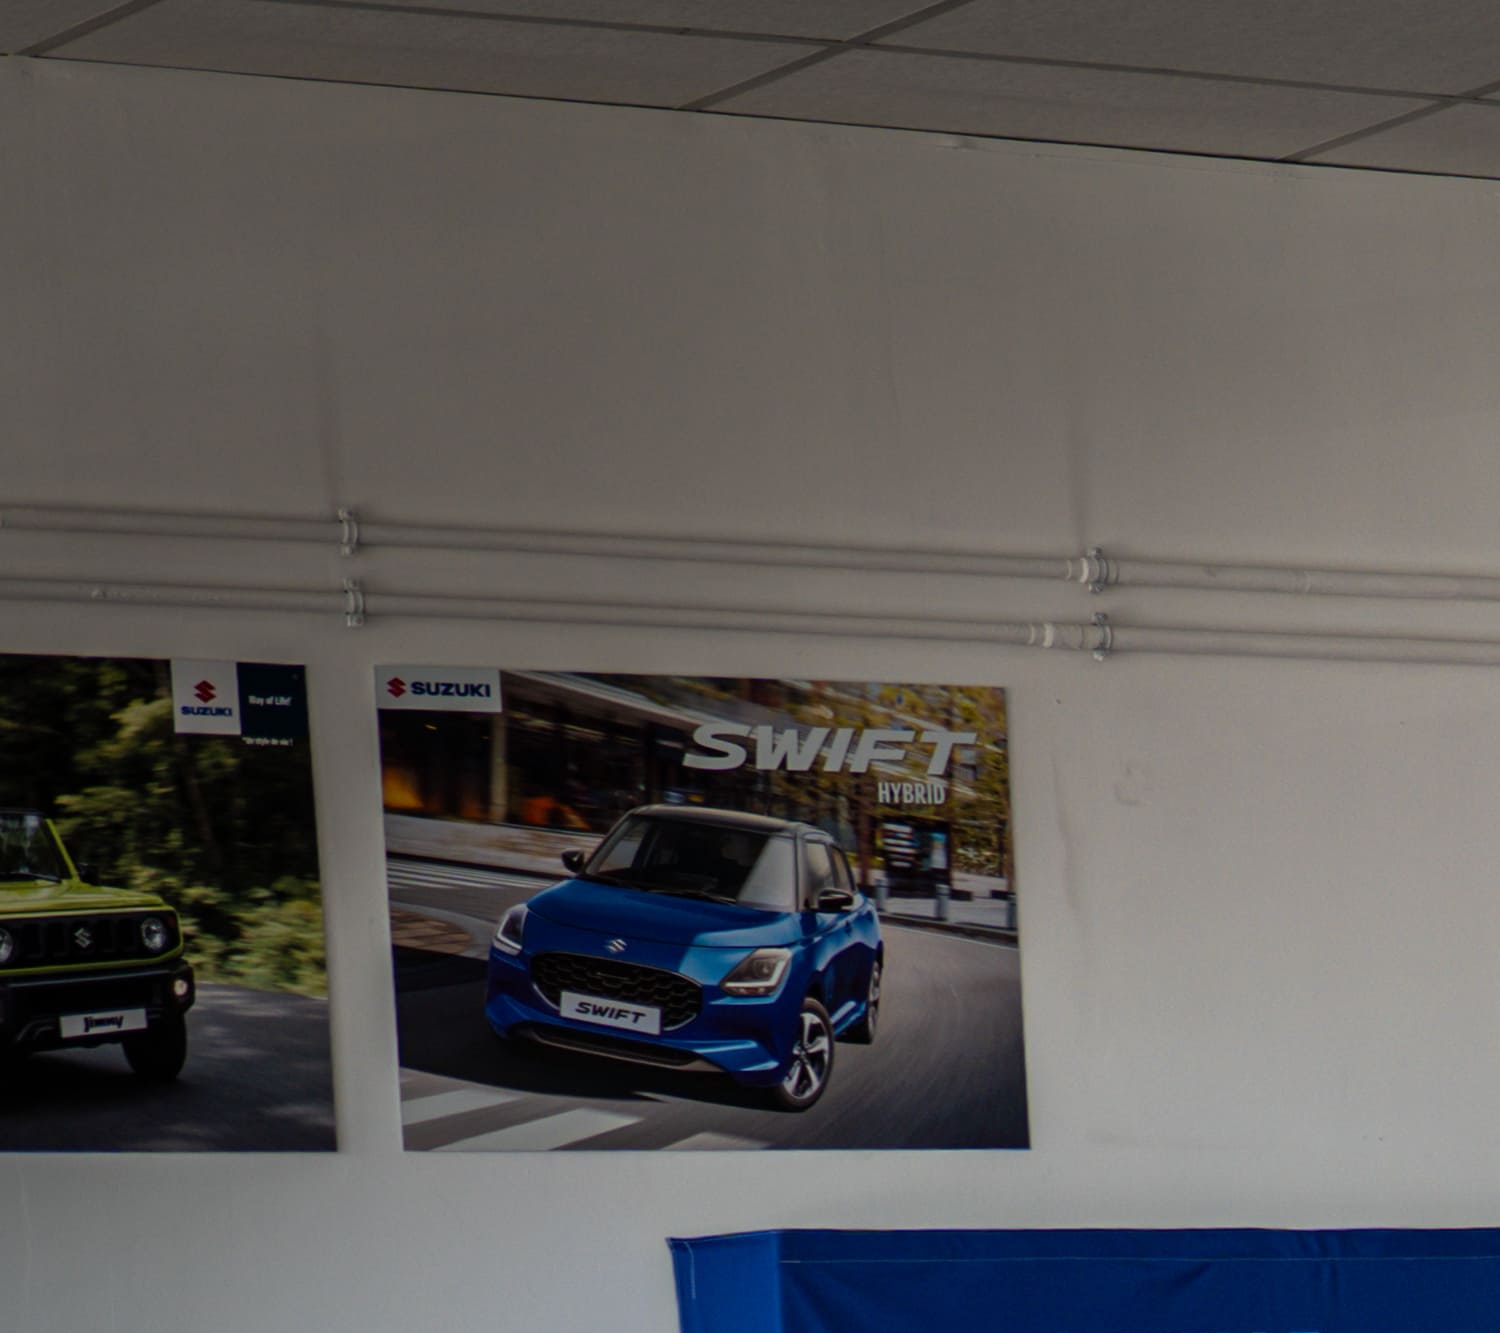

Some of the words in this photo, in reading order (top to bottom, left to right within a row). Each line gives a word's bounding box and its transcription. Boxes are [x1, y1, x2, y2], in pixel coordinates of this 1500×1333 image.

[411, 681, 491, 698] SUZUKI
[181, 706, 233, 717] SUZUKI
[682, 723, 977, 776] SWIFT
[877, 781, 946, 805] HYBRID
[575, 1001, 646, 1024] SWIFT
